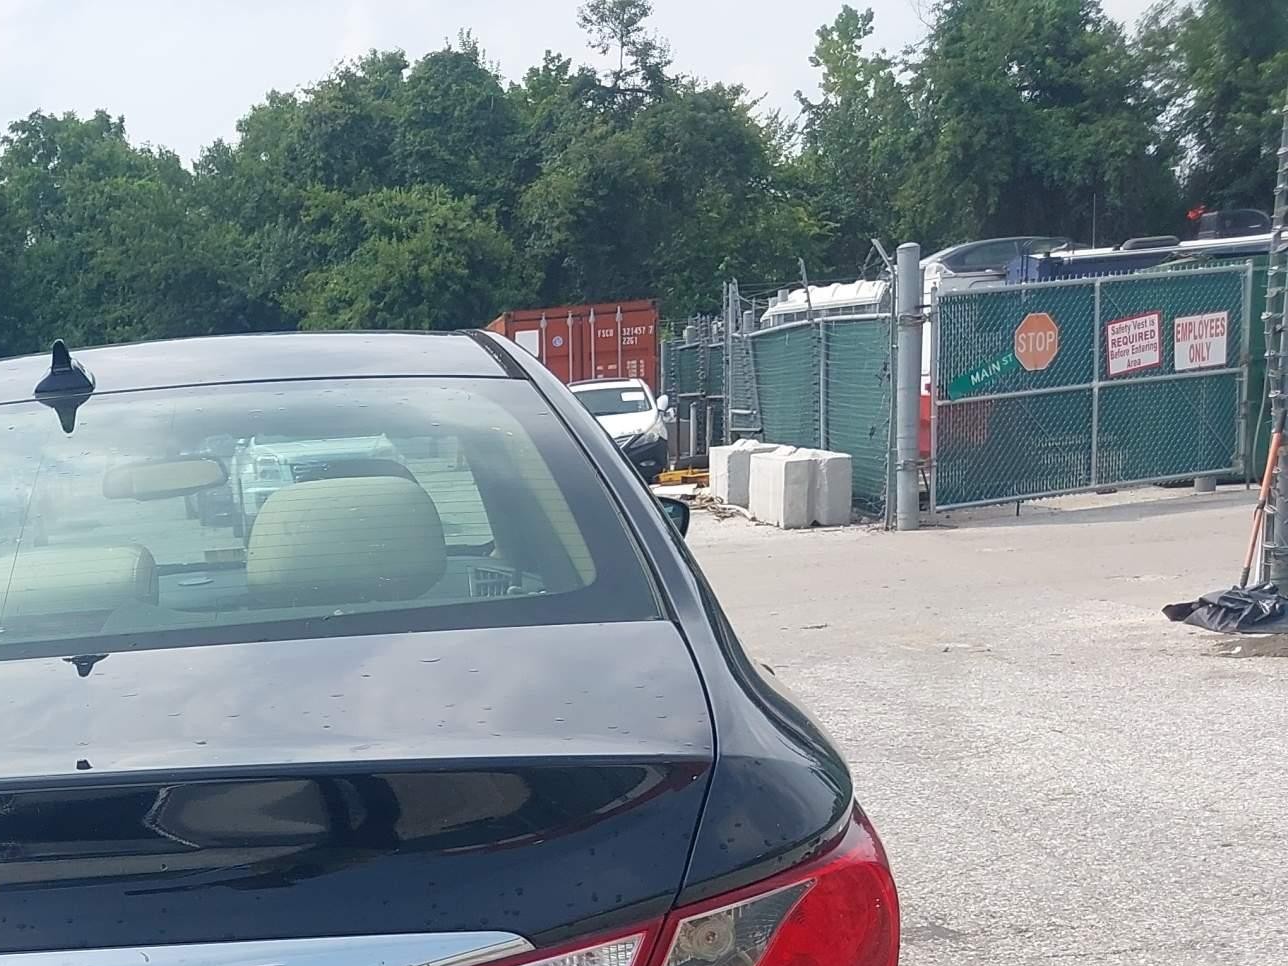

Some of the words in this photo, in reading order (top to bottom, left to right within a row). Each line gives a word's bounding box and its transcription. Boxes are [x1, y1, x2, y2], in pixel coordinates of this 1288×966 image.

[1111, 323, 1131, 336] Safety
[1132, 319, 1147, 331] Vest
[1149, 317, 1155, 327] is
[1175, 317, 1225, 343] EMPLOYEES
[1018, 331, 1055, 353] STOP
[1111, 329, 1156, 349] REQUIRED
[1110, 348, 1130, 360] Before
[1132, 341, 1158, 354] Entering
[1189, 341, 1211, 363] ONLY
[970, 361, 1001, 385] MAIN
[1001, 353, 1013, 366] ST
[1127, 358, 1141, 368] Area
